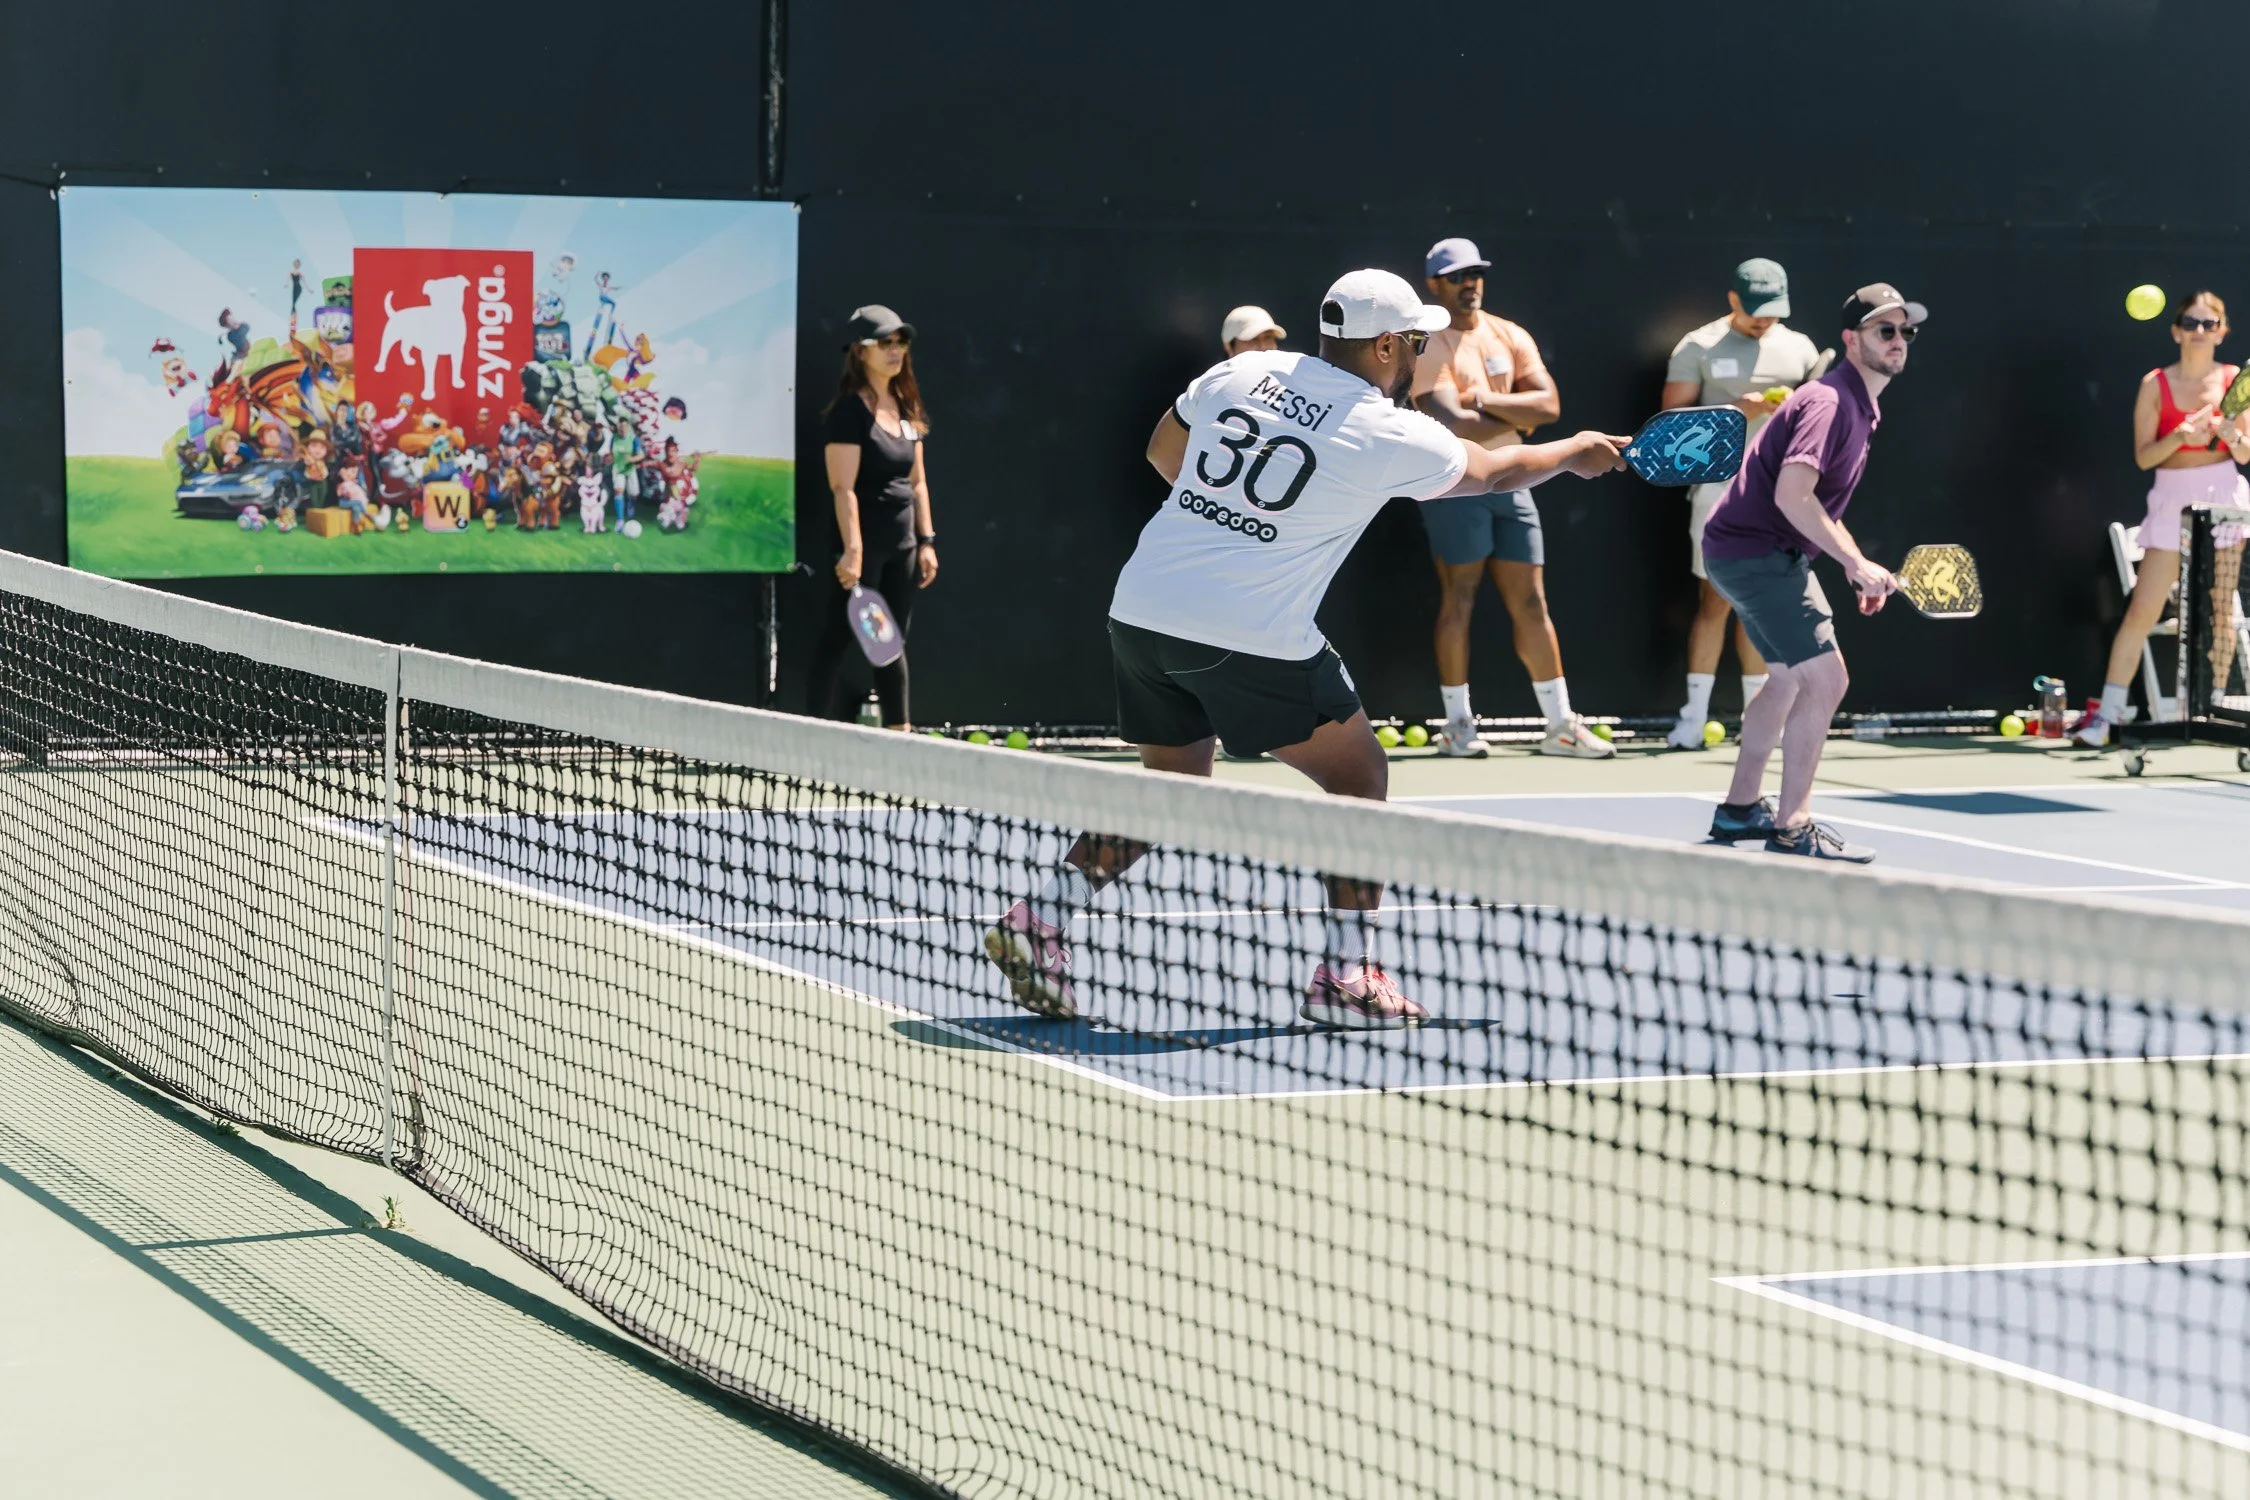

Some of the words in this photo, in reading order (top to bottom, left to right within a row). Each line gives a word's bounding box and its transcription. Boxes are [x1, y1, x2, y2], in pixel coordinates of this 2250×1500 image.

[477, 277, 513, 399] zynga
[1196, 409, 1317, 513] 30
[434, 495, 461, 518] W
[1180, 490, 1276, 541] ooredoo
